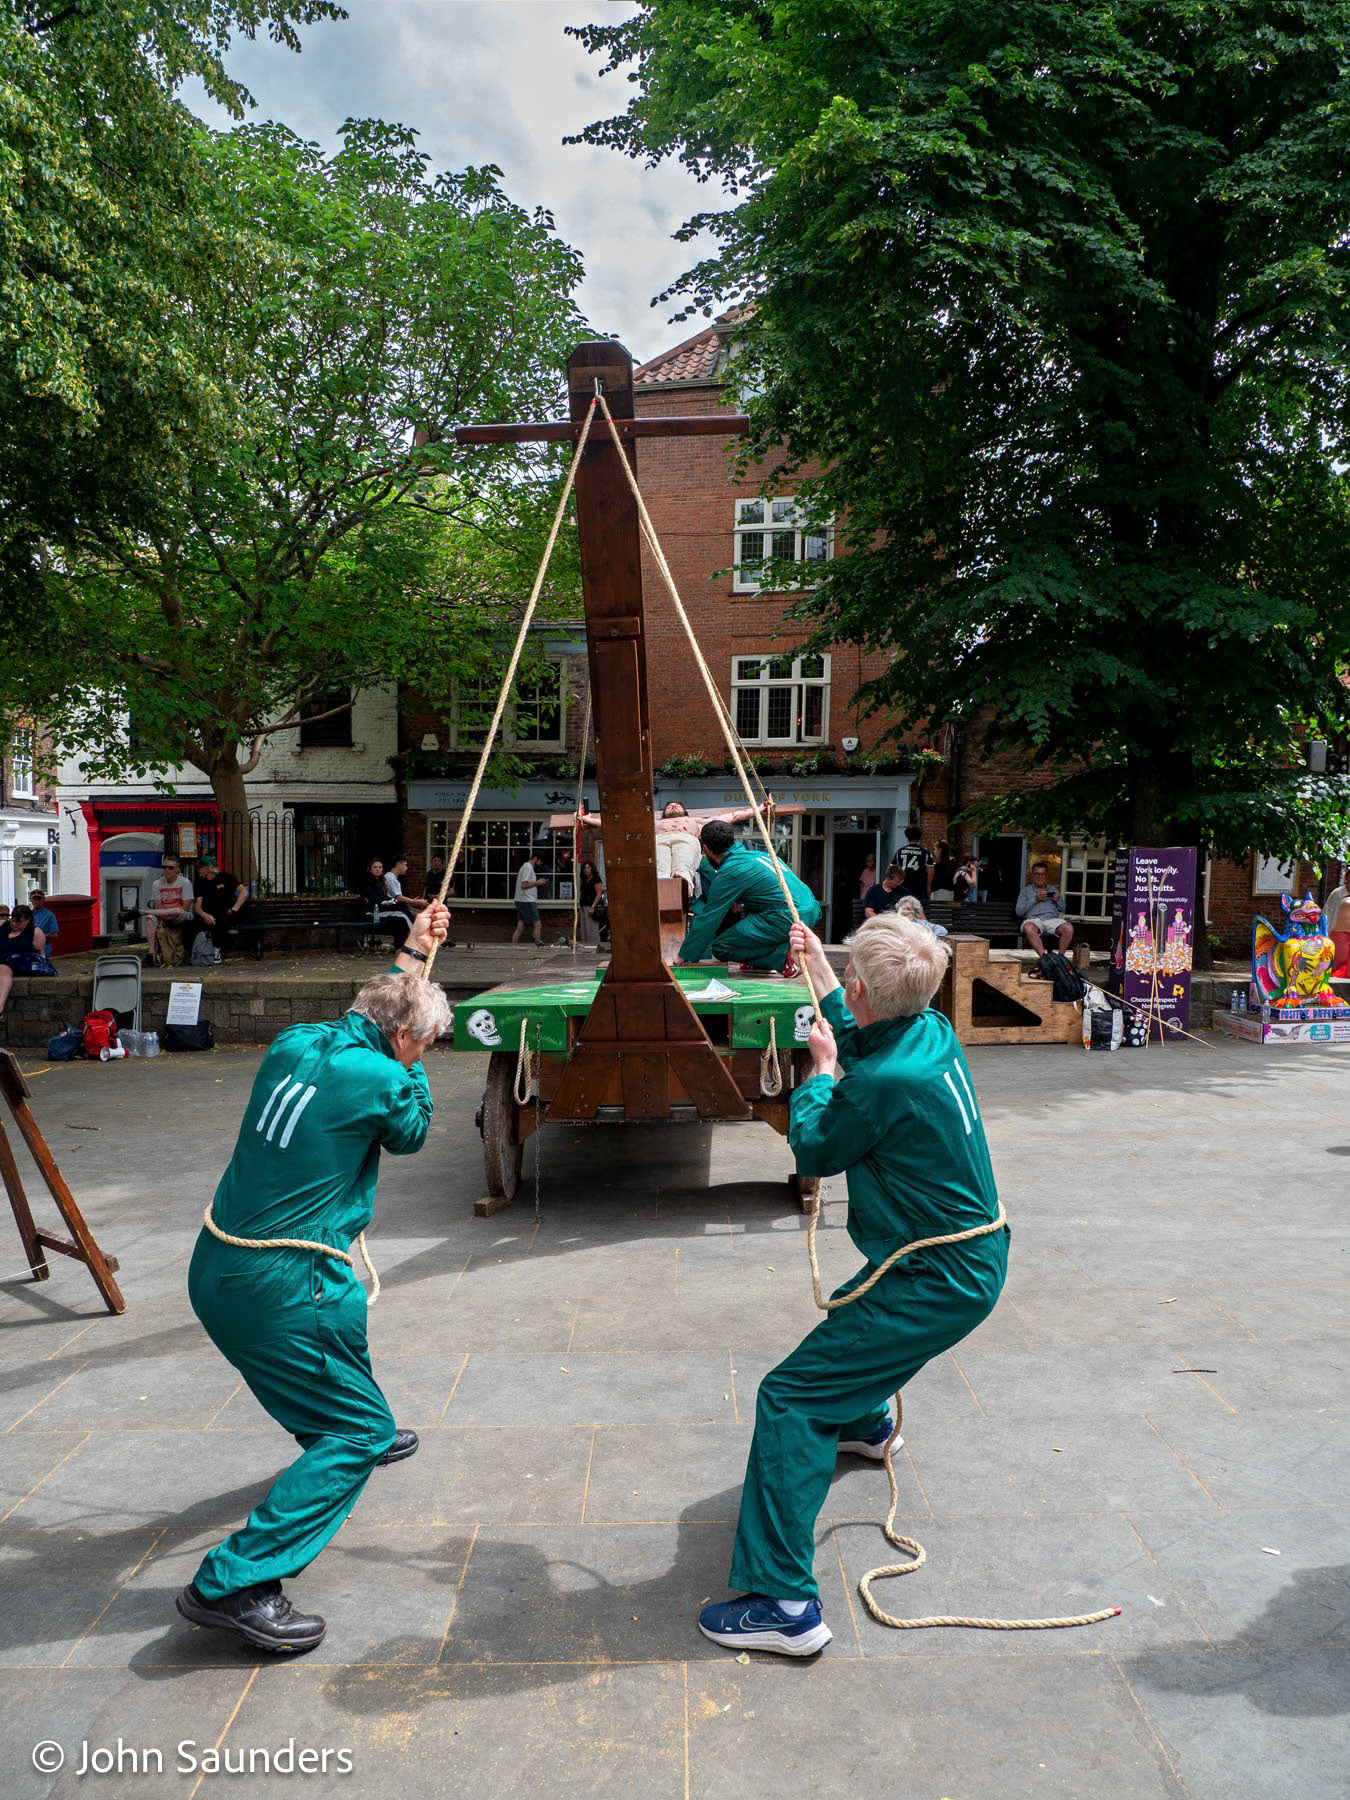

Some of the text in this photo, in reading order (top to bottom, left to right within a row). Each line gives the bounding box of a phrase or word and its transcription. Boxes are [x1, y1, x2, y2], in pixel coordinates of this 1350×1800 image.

[793, 792, 831, 801] YORK
[900, 855, 919, 871] 14
[1135, 857, 1158, 865] Leave
[1135, 866, 1153, 874] York
[1135, 875, 1147, 883] No
[1134, 884, 1152, 892] Jus
